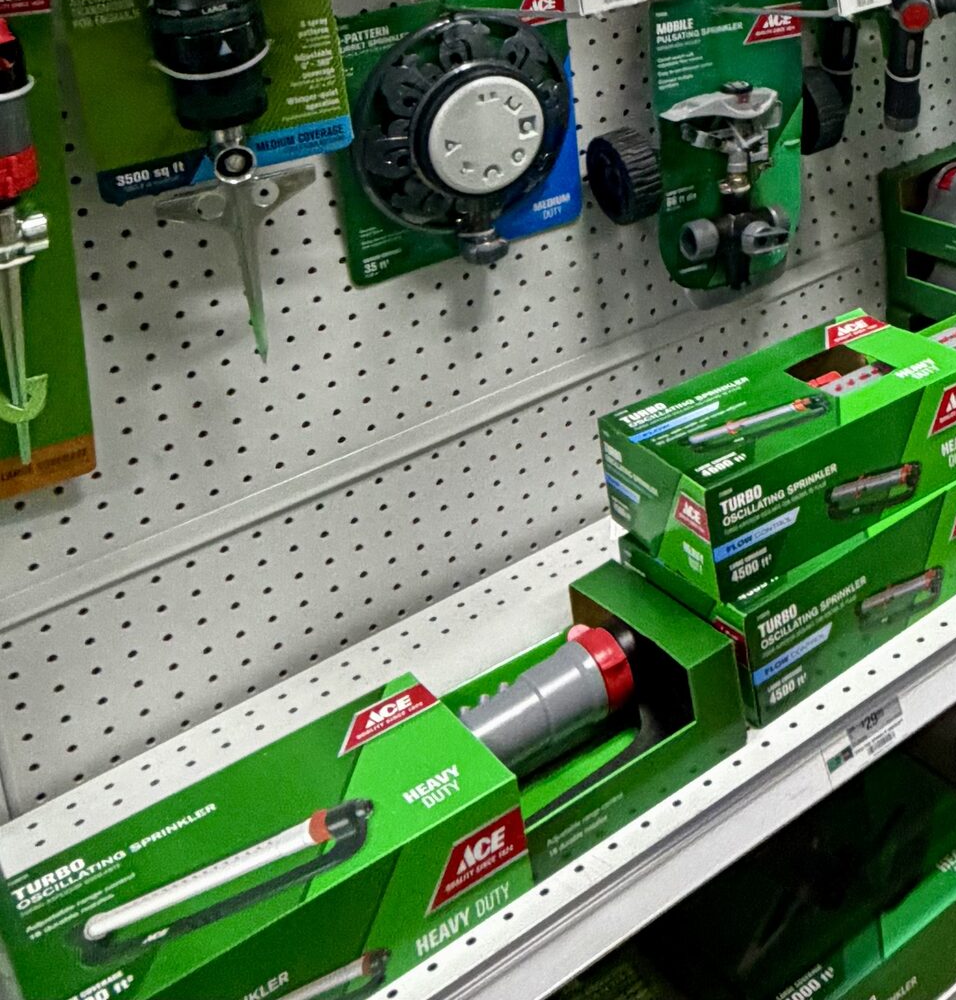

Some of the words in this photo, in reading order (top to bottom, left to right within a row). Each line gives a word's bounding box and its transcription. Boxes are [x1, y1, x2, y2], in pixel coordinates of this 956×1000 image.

[341, 25, 390, 45] -PATTERN
[656, 18, 694, 36] MOBILE
[762, 14, 793, 29] ACE
[656, 30, 700, 44] PULSATING
[116, 169, 151, 188] 3500
[153, 165, 172, 180] sq
[173, 161, 185, 174] ft
[837, 319, 869, 337] ACE
[619, 402, 668, 424] TURBO
[719, 484, 763, 516] TURBO
[722, 491, 786, 527] OSCILLATING
[786, 462, 839, 496] SPRINKLER
[725, 535, 754, 554] FLOW
[731, 560, 761, 583] 4500
[757, 603, 798, 639] TURBO
[760, 606, 819, 650] OSCILLATING
[819, 575, 868, 613] SPRINKLER
[764, 655, 790, 677] FLOW
[768, 681, 797, 705] 4500
[364, 694, 412, 730] ACE
[402, 764, 460, 804] HEAVY
[421, 779, 461, 809] DUTY
[16, 850, 127, 911] OSCILLATING
[128, 802, 217, 854] SPRINKLER
[456, 825, 506, 876] ACE
[11, 857, 86, 902] TURBO
[415, 906, 471, 957] HEAVY
[475, 881, 511, 918] DUTY
